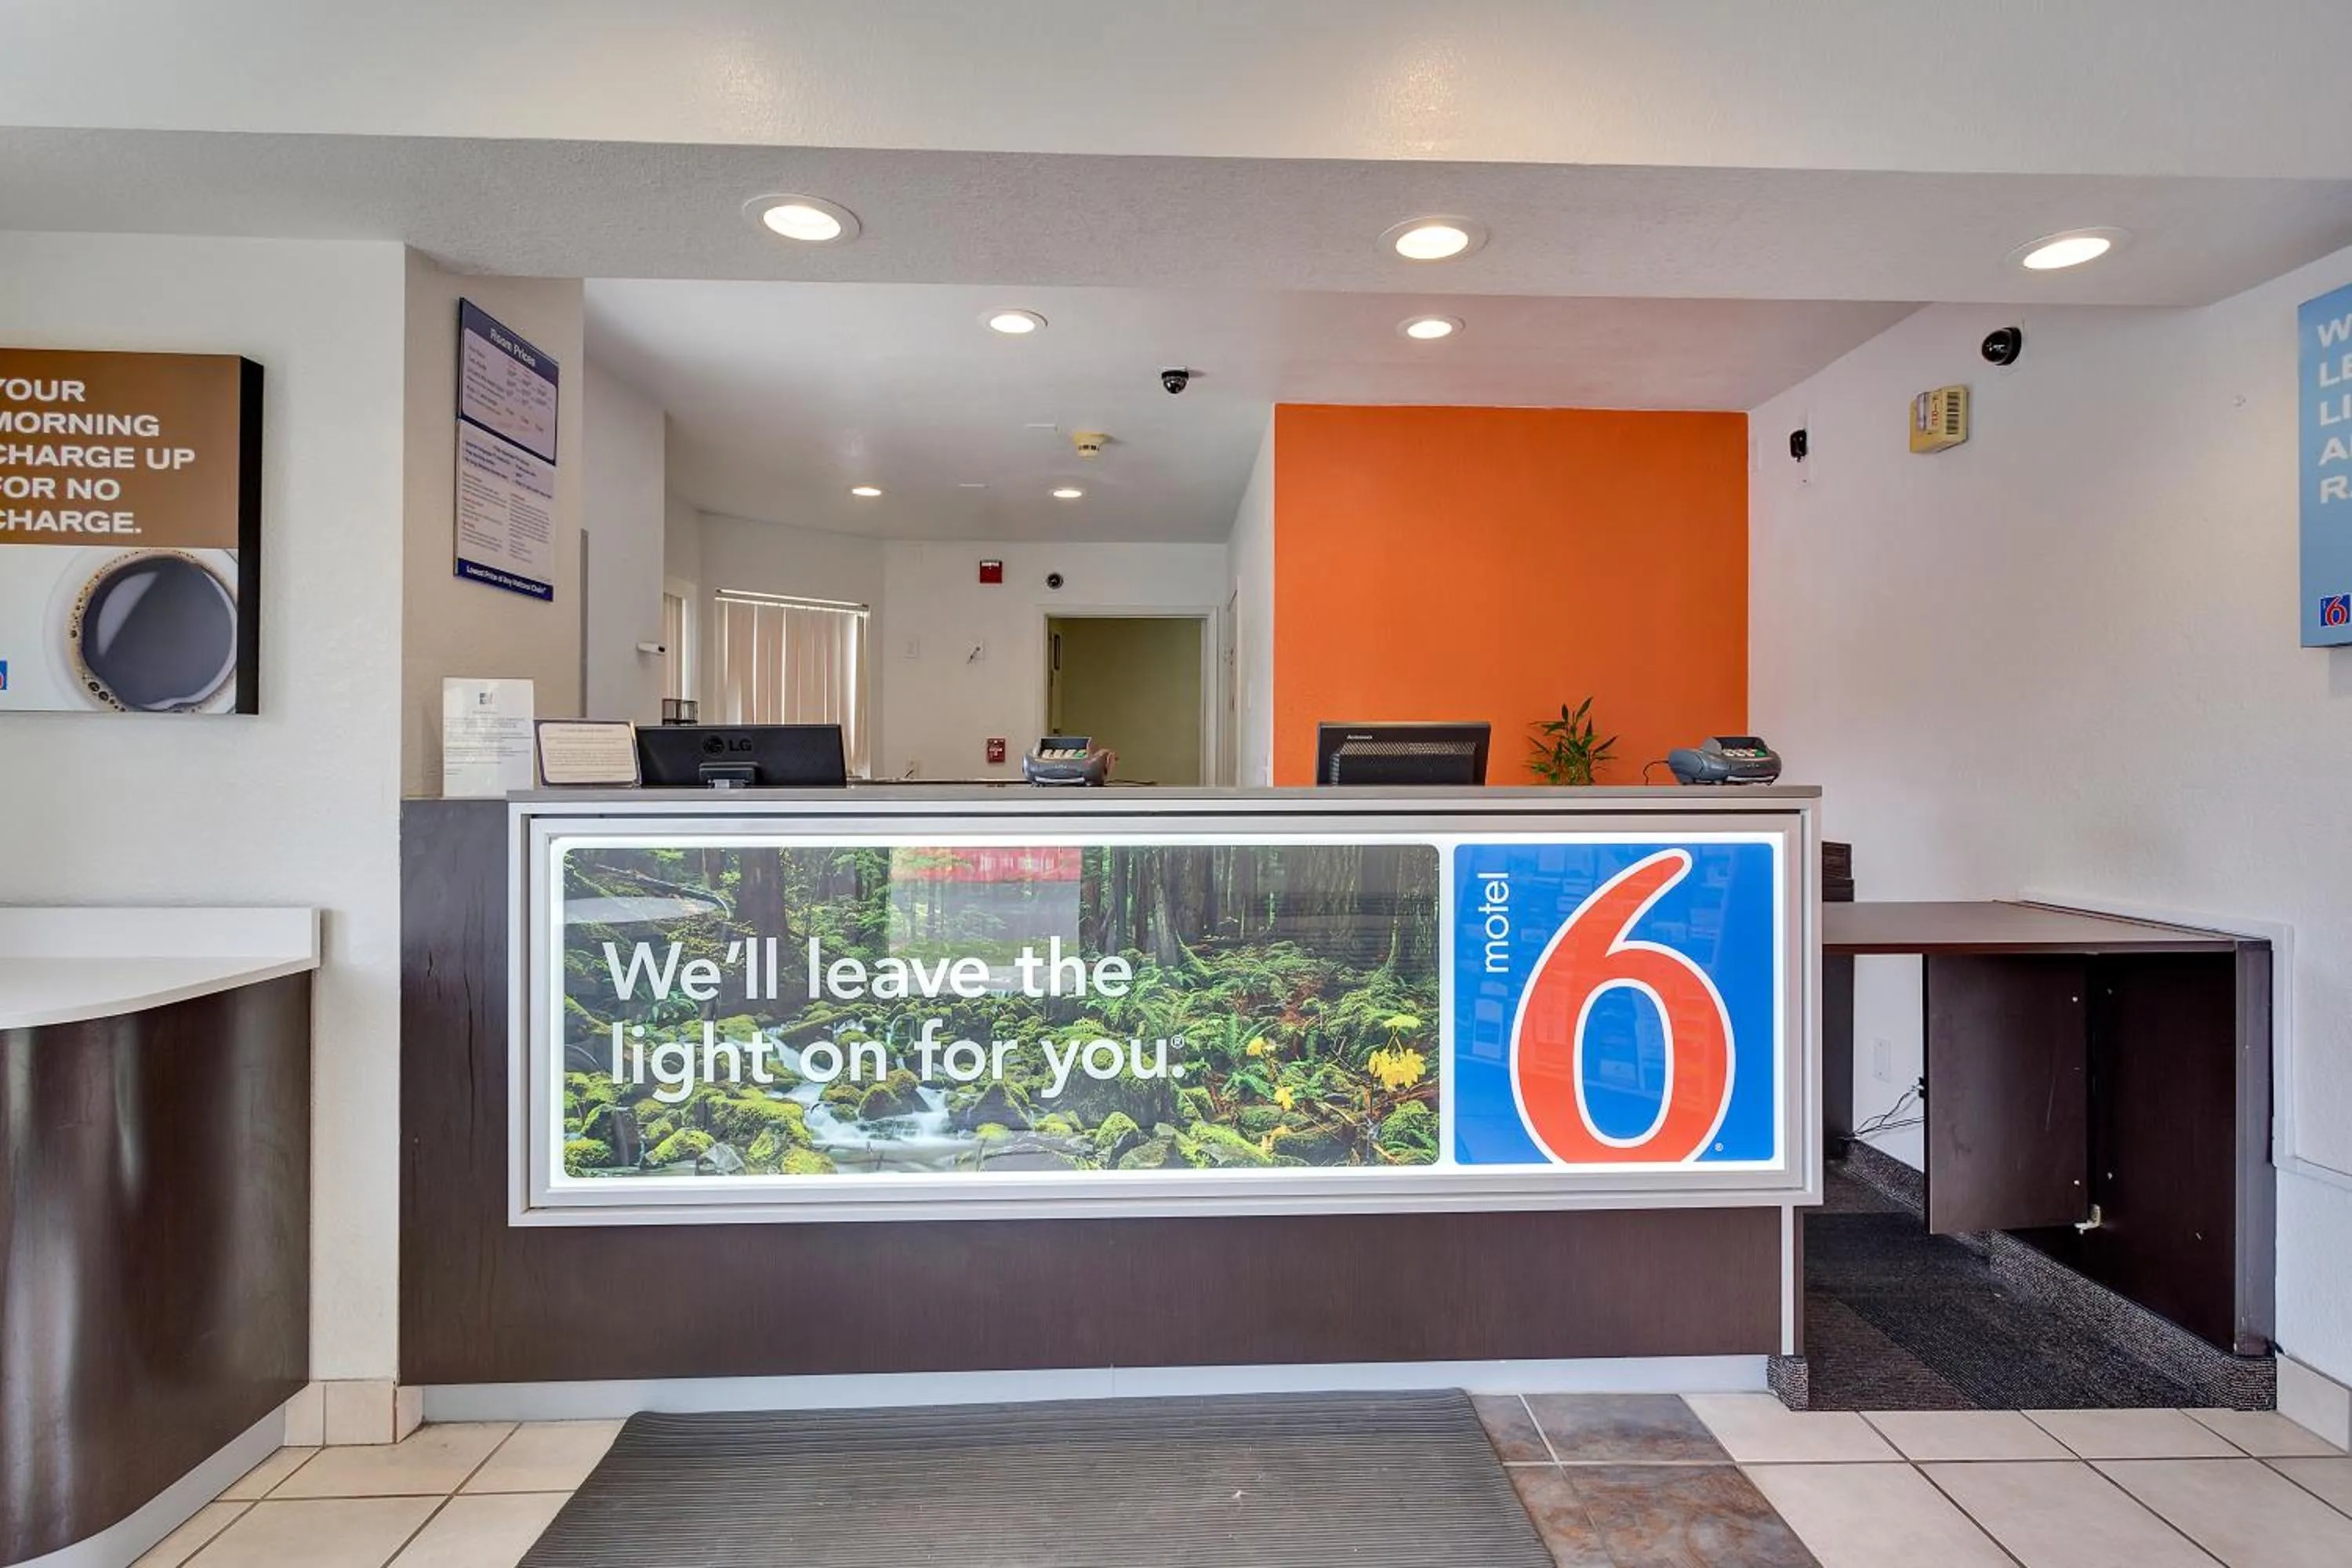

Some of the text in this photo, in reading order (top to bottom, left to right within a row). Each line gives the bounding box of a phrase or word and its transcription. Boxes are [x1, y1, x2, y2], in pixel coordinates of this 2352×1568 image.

[513, 343, 536, 367] Prices
[0, 378, 85, 402] OUR
[146, 448, 195, 470] UP
[2318, 437, 2352, 466] A
[0, 476, 121, 502] OR NO
[0, 509, 142, 534] HARGE.
[728, 738, 753, 752] LG
[808, 937, 990, 999] leave
[1014, 935, 1133, 997] the
[1477, 848, 1737, 1164] motel 6
[612, 1021, 774, 1102] light
[799, 1040, 887, 1082] on
[913, 1018, 1018, 1080] for
